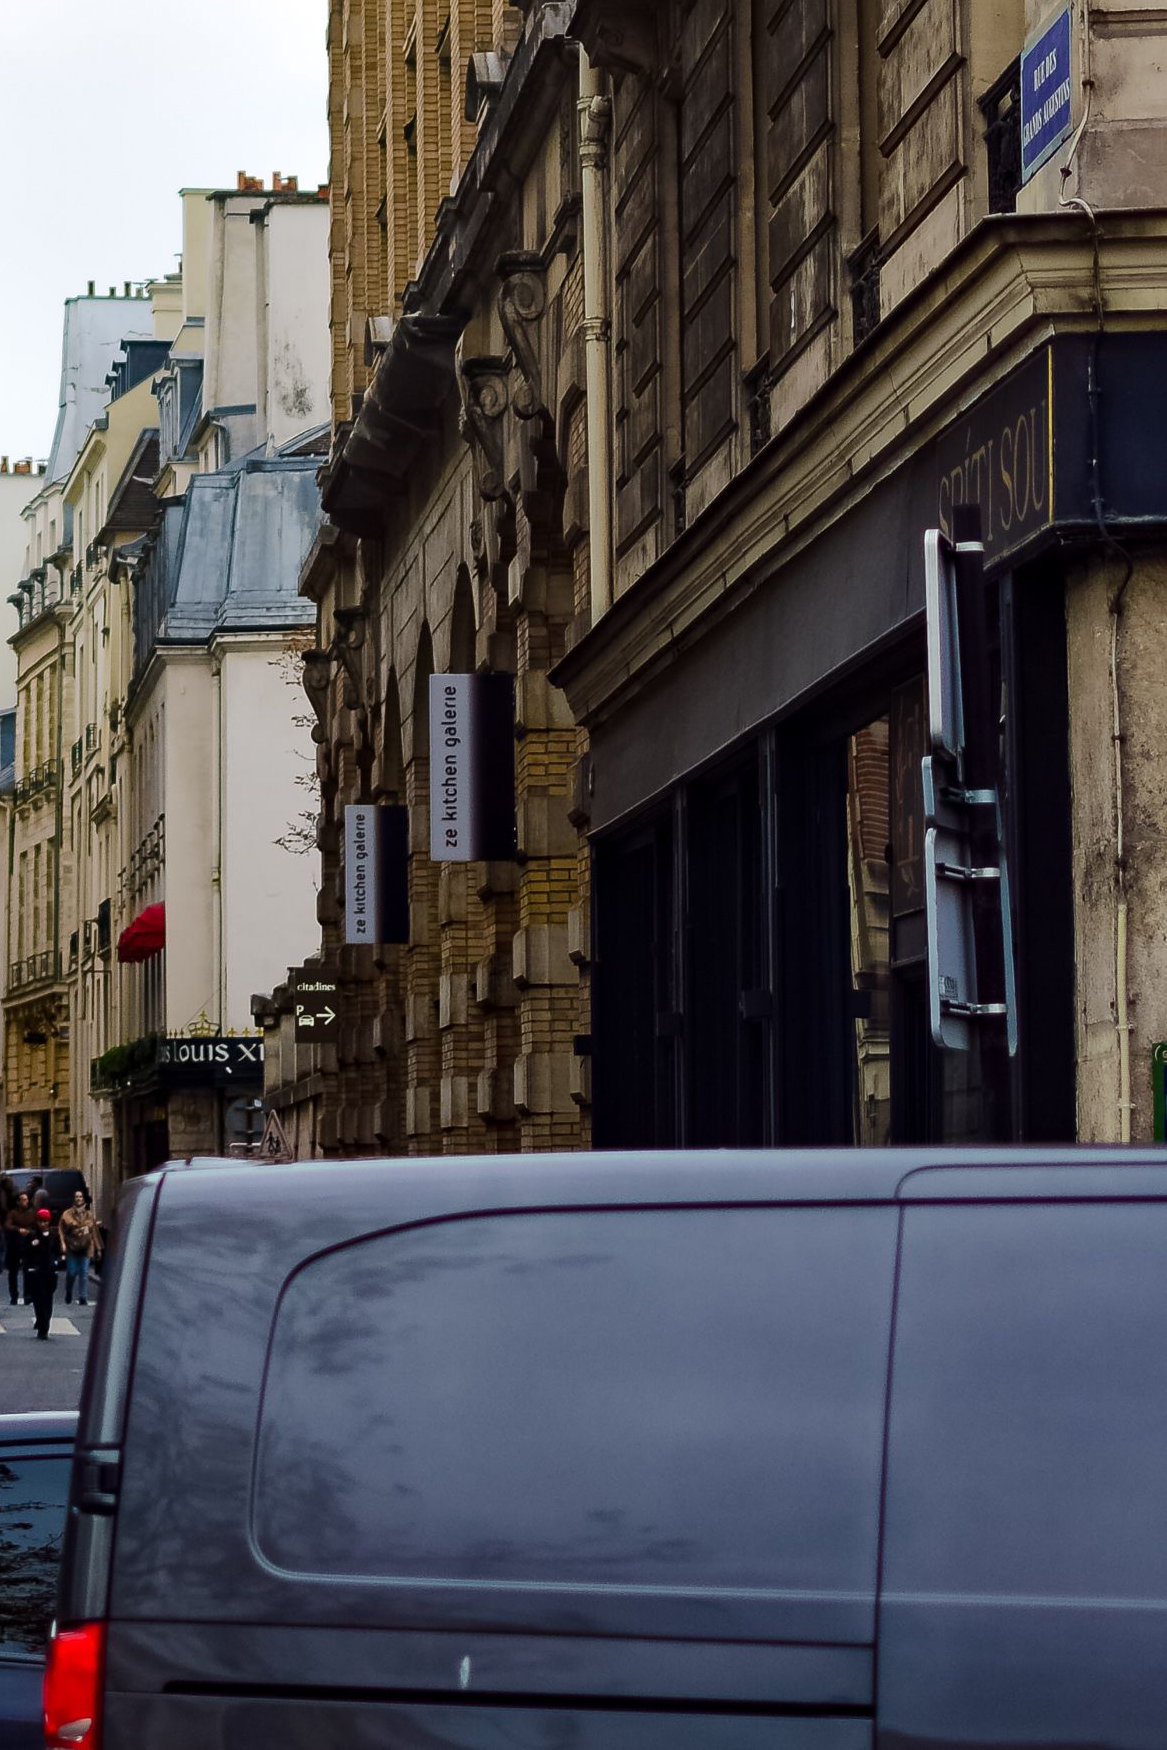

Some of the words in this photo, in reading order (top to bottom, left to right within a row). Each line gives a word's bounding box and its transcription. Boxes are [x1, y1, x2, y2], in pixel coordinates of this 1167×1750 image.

[1034, 60, 1045, 92] RUE
[1045, 48, 1057, 78] DES
[1023, 108, 1043, 147] GRANDS
[1000, 399, 1046, 531] SOU
[441, 685, 461, 748] galerie
[441, 755, 458, 821] kitchen
[445, 828, 458, 848] ze
[356, 919, 366, 934] ze
[297, 982, 336, 991] citadines
[296, 1004, 304, 1016] P
